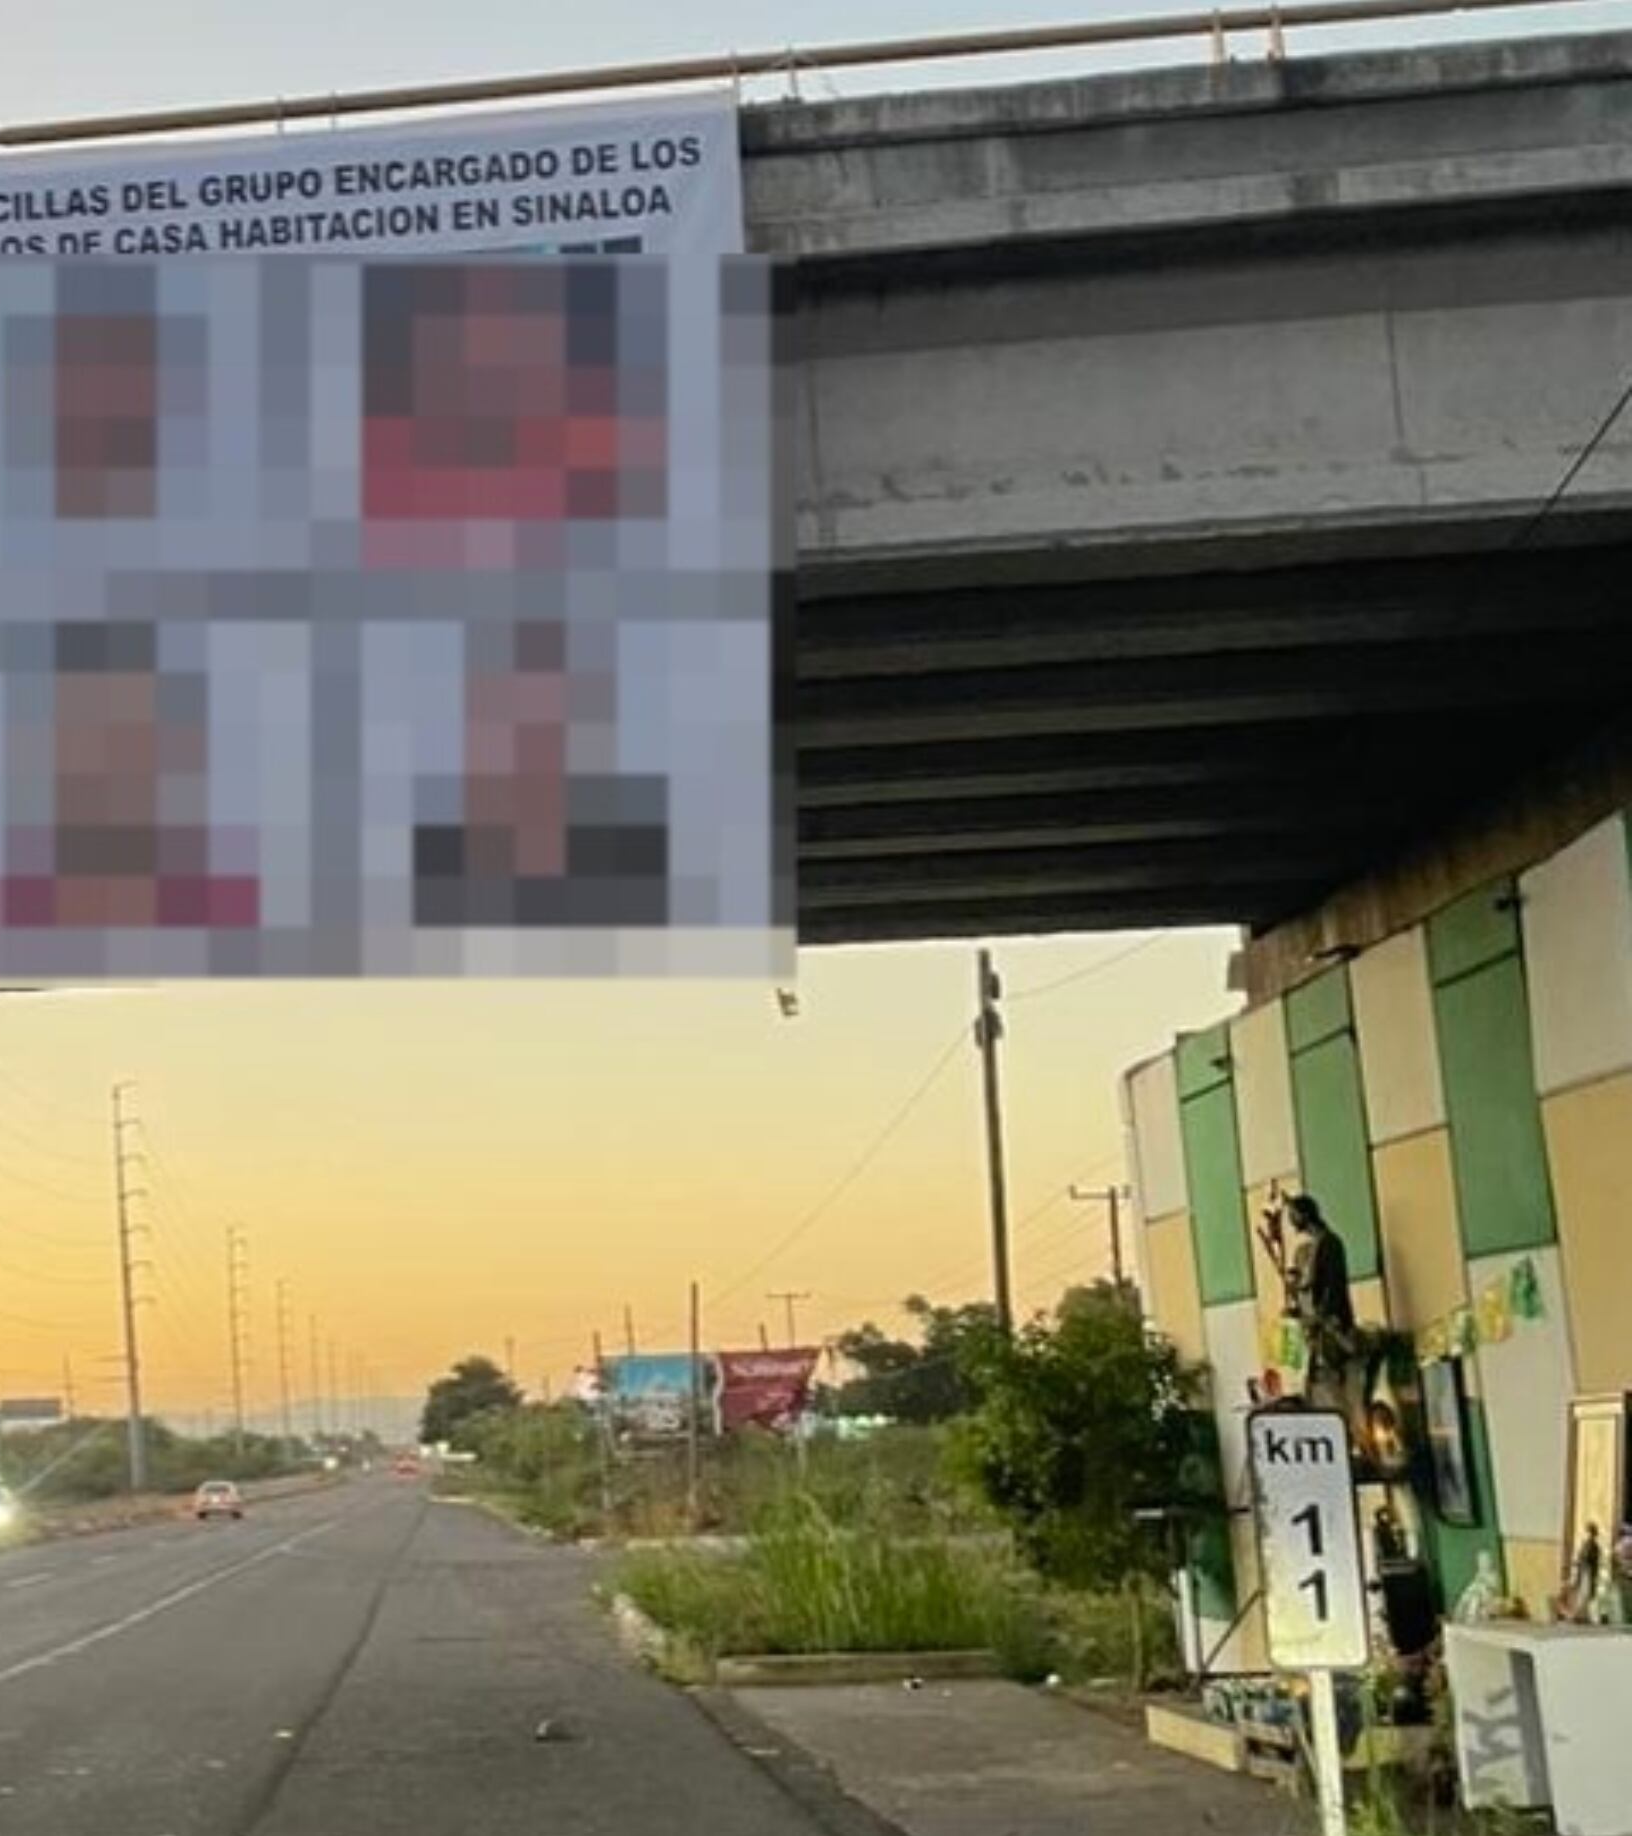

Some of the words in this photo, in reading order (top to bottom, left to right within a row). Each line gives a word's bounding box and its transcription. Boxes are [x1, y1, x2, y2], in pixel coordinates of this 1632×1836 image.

[122, 181, 188, 212] DEL
[199, 169, 322, 206] GRUPO
[334, 150, 559, 195] ENCARGADO
[572, 144, 618, 176] DE
[631, 137, 700, 171] LOS
[58, 230, 101, 254] DE
[115, 223, 209, 254] CASA
[220, 204, 438, 249] HABITACION
[453, 199, 499, 230] EN
[512, 185, 671, 226] SINALOA
[1264, 1428, 1334, 1464] km
